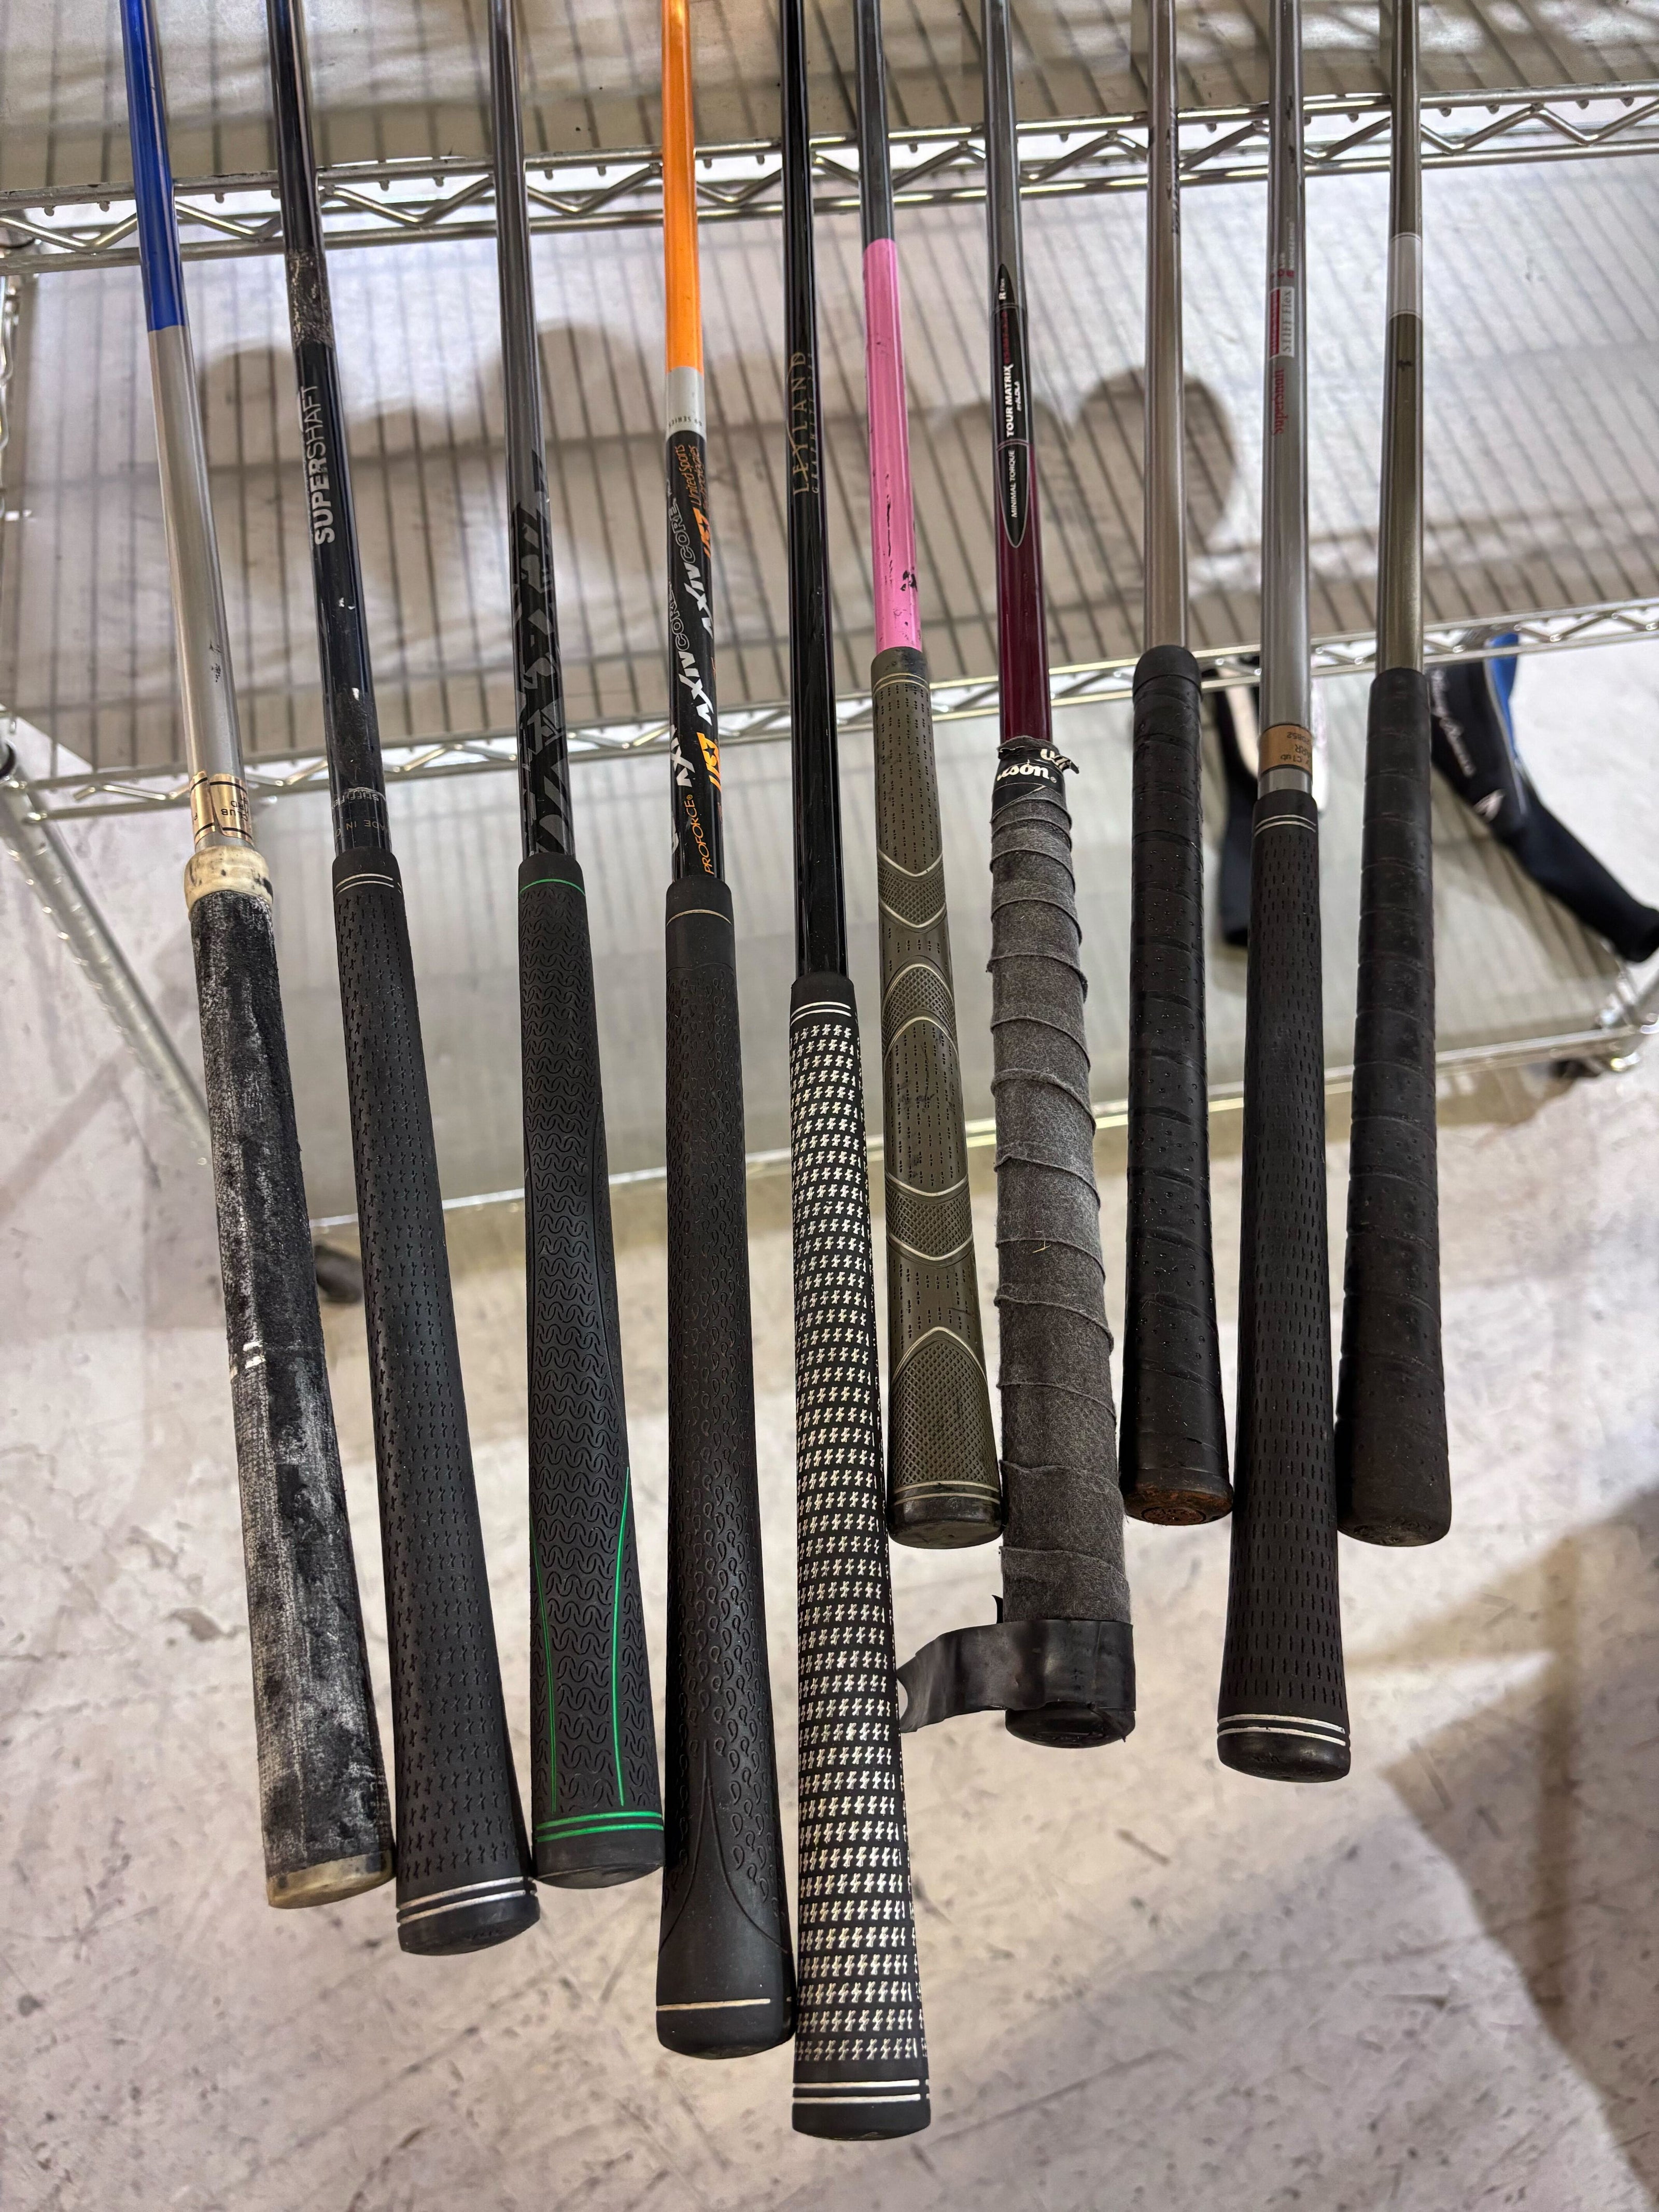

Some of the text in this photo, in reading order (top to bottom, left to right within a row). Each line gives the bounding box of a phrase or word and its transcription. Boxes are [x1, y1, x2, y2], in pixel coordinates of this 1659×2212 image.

[1003, 362, 1014, 406] MATRIX
[789, 351, 809, 496] LEYLAND
[1005, 406, 1015, 438] TOUR
[299, 385, 336, 546] SUPERSHAFT
[1007, 448, 1016, 482] TORQUE
[684, 472, 701, 506] United
[345, 819, 386, 832] ADE IN
[685, 800, 715, 875] PROFORCE
